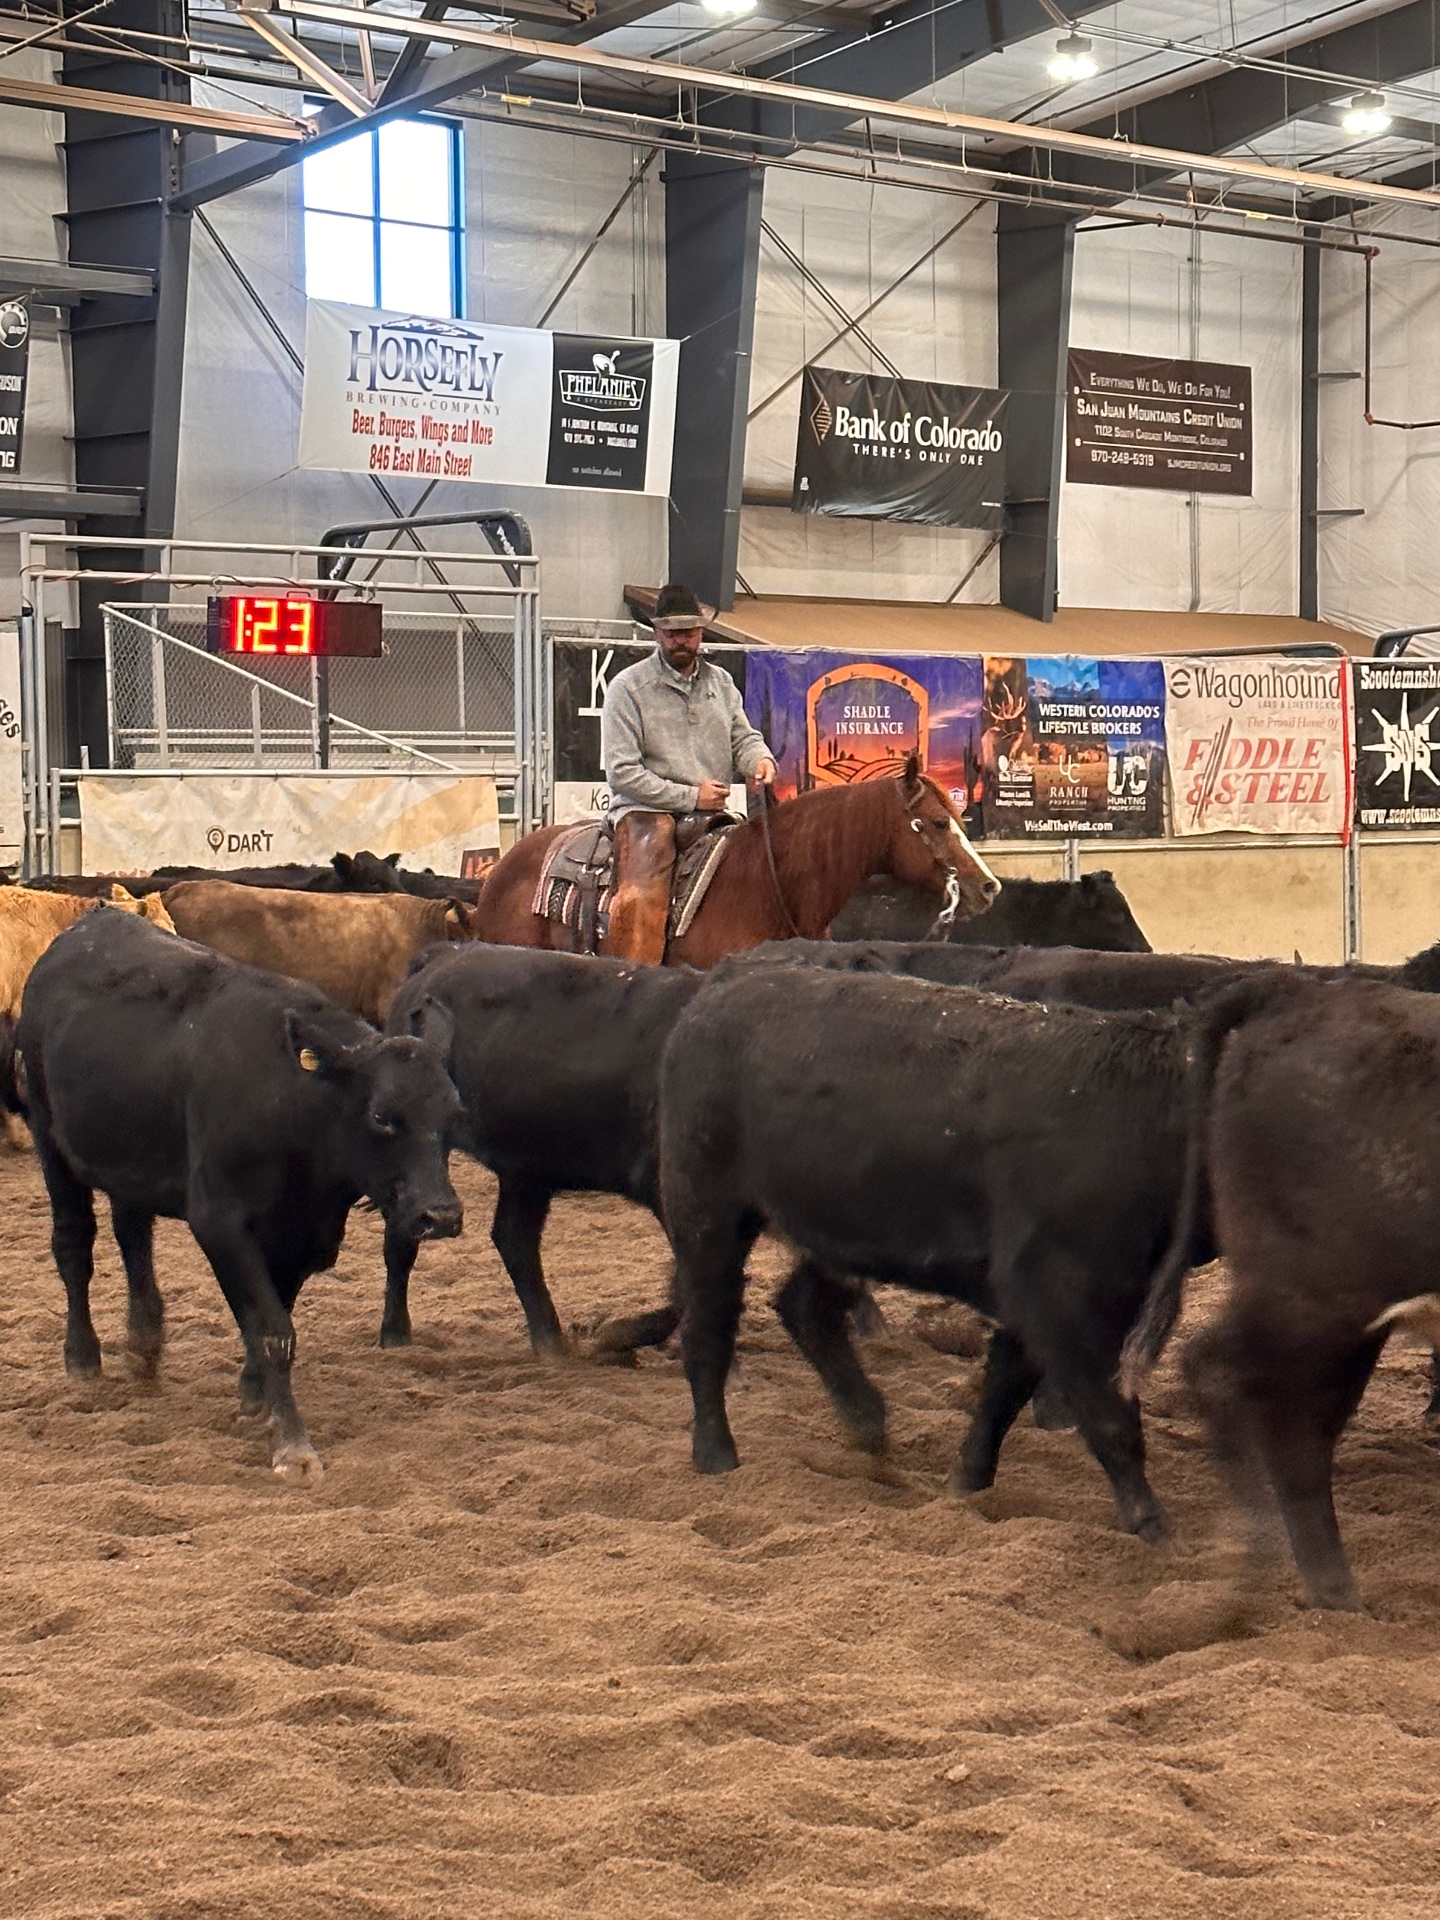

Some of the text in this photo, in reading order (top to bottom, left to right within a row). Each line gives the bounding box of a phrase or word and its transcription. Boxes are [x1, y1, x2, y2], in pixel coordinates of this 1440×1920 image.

[347, 325, 503, 401] HORSEFLY
[566, 374, 637, 406] PHELANIES
[346, 391, 501, 416] BREWING COMPANY
[379, 411, 418, 443] Burgers,
[421, 415, 449, 447] Wings
[452, 419, 469, 444] and
[471, 420, 493, 445] More
[835, 406, 1003, 452] Bank of Colorado
[370, 444, 472, 476] 846 East Main Street
[853, 443, 984, 466] THERE'S ONLY ONE
[235, 599, 311, 653] 1:23
[1194, 666, 1342, 708] Wagonhound
[843, 705, 891, 719] SHADLE
[1039, 704, 1160, 719] WESTERN COLORADO'S
[836, 722, 904, 735] INSURANCE
[1039, 721, 1142, 735] LIFESTYLE BROKERS
[1049, 786, 1088, 798] RANCH
[1025, 819, 1113, 832] WeSellTheWest.com
[227, 829, 273, 853] DART
